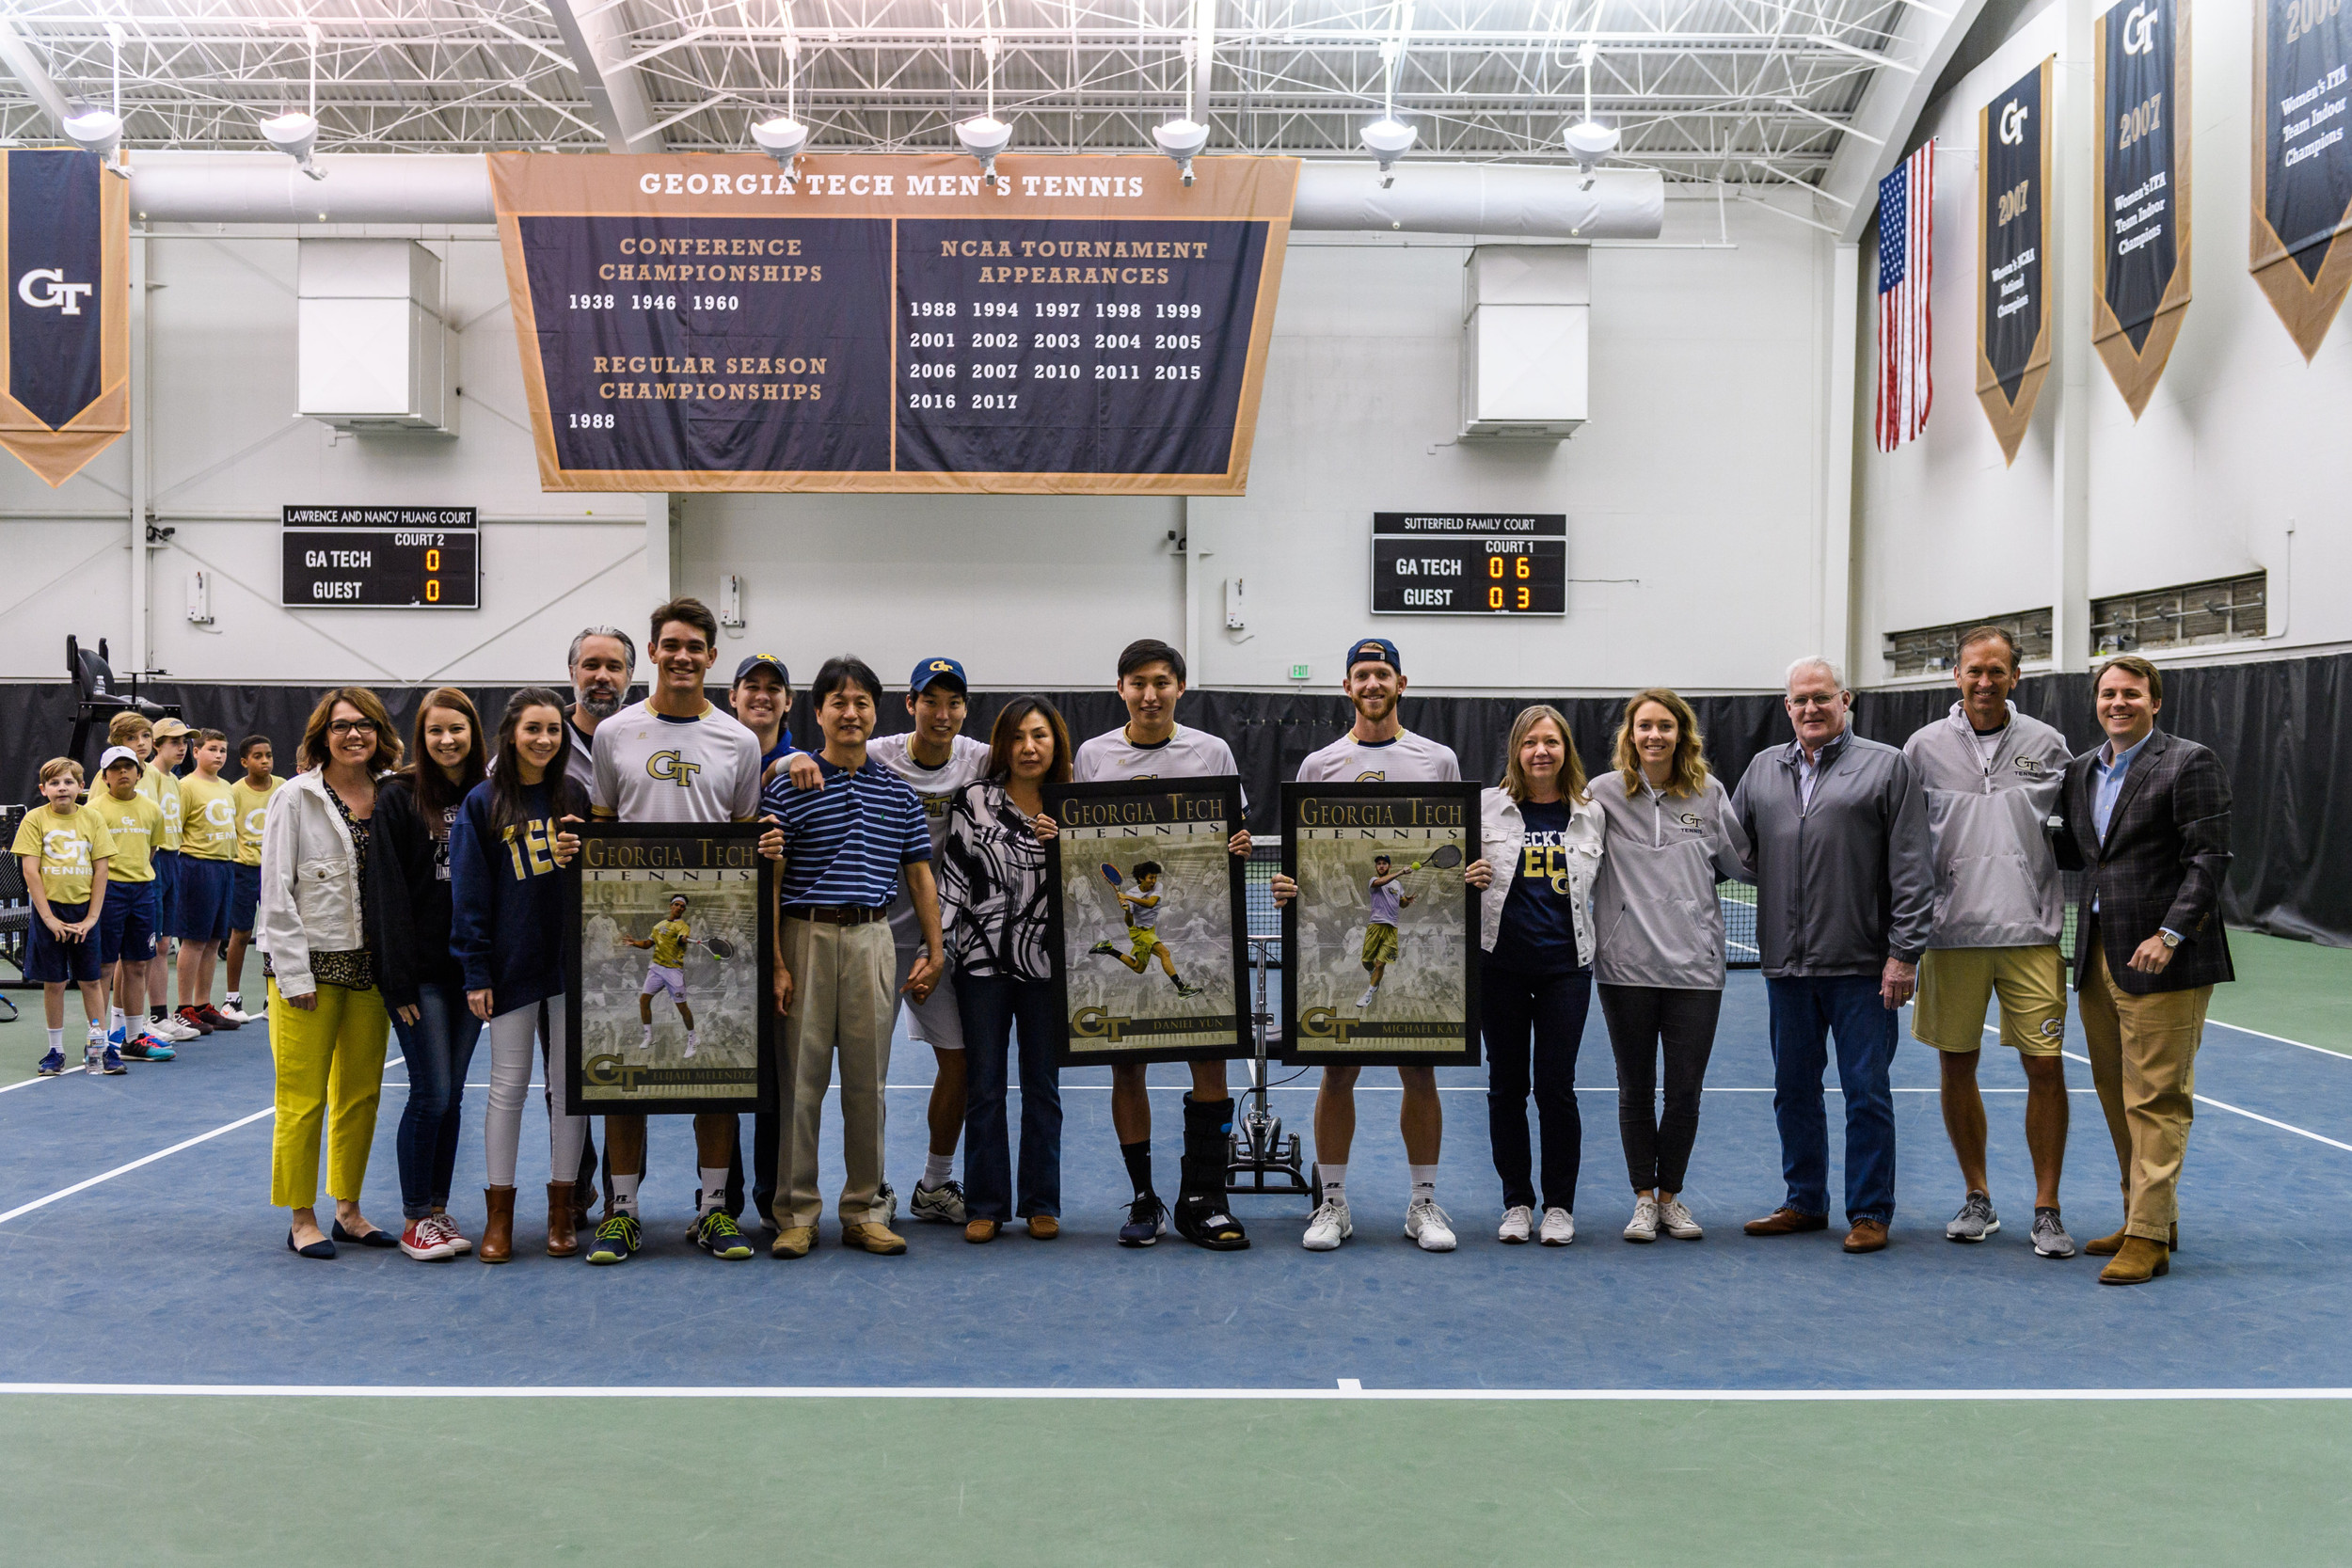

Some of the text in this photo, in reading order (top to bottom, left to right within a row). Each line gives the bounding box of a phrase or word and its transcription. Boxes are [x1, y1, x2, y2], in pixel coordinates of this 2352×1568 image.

[2123, 1, 2158, 55] GT
[2280, 64, 2348, 117] Women's ITA
[1999, 98, 2028, 146] GT
[2120, 92, 2161, 150] 2007
[2282, 97, 2347, 143] Team Indoor
[2285, 127, 2344, 167] Champions
[640, 173, 1144, 198] GEORGIA TECH MENS TENNIS
[1998, 179, 2028, 227] 2007
[2115, 198, 2166, 234] Team Indoor
[619, 238, 802, 256] CONFERENCE
[2118, 224, 2162, 255] Champions
[941, 240, 1208, 259] NCAA TOURNAMENT
[598, 263, 822, 282] CHAMPIONSHIPS
[978, 267, 1169, 284] APPEARANCES
[18, 268, 92, 315] GT
[569, 294, 739, 310] 1938 1946 1960
[910, 302, 1201, 318] 1988 1994 1997 1998 1999
[910, 333, 1201, 349] 2001 2002 2003 2004 2005
[594, 356, 827, 374] REGULAR SEASON
[910, 363, 1200, 380] 2006 2007 2010 2011 2015
[599, 383, 822, 401] CHAMPIONSHIPS
[910, 394, 1018, 409] 2016 2017
[569, 413, 615, 429] 1988
[288, 510, 471, 524] LAWRENCE AND NANCY HUANG COURT
[1405, 517, 1535, 531] SUTTERFIELD FAMILY COURT
[395, 533, 444, 546] COURT 2
[1486, 541, 1534, 553] COURT 1
[306, 550, 372, 568] GA TECH
[426, 549, 439, 571] 0
[1396, 559, 1462, 576] GA TECH
[1489, 556, 1530, 578] 0 6
[313, 581, 362, 599] GUEST
[426, 579, 439, 602] 0
[1404, 588, 1453, 606] GUEST
[1489, 586, 1530, 609] 0 3
[1294, 664, 1309, 677] EXIT
[646, 750, 701, 787] GT
[2014, 755, 2039, 771] GT
[1062, 793, 1223, 826] GEORGIA TECH
[1300, 798, 1462, 826] GEORGIA TECH
[1680, 813, 1703, 828] GT
[1066, 822, 1219, 840] TENNIS
[1304, 829, 1457, 839] TENNIS
[43, 830, 93, 865] GT
[585, 838, 754, 866] GEORGIA TECH
[42, 866, 93, 876] TENNIS
[589, 870, 750, 881] TENNIS
[1072, 1006, 1131, 1043] GT
[1153, 1019, 1223, 1030] DANIEL YUN
[1300, 1006, 1359, 1044] GT
[1382, 1024, 1461, 1034] MICHAEL KAY
[585, 1053, 648, 1092] GT
[653, 1069, 755, 1082] ELIJAH MELENDEZ
